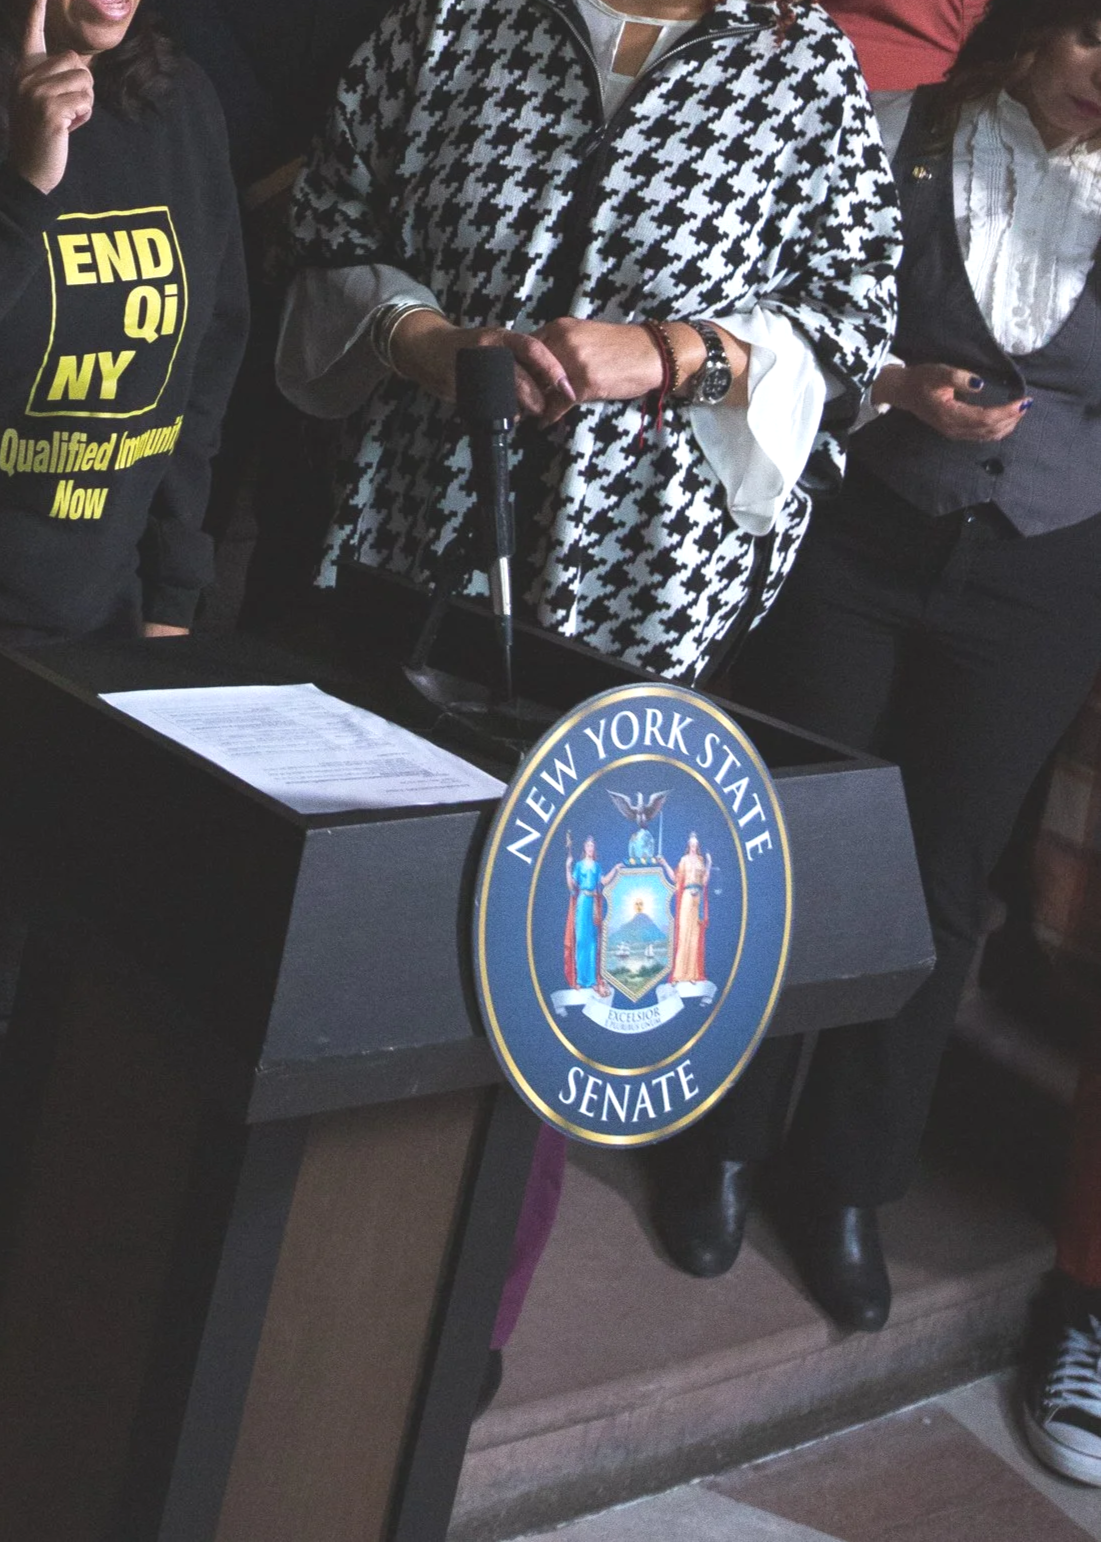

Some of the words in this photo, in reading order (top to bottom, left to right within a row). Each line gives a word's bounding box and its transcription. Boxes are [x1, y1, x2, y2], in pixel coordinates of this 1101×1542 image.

[57, 227, 174, 286] END
[124, 283, 178, 343] Qi
[47, 350, 136, 401] NY
[0, 428, 117, 477] Qualified
[49, 480, 109, 521] Now
[506, 757, 581, 864] NEW
[583, 706, 695, 760] YORK
[696, 730, 774, 862] STATE
[607, 1006, 661, 1024] EXCELSIOR
[558, 1058, 700, 1124] SENATE
